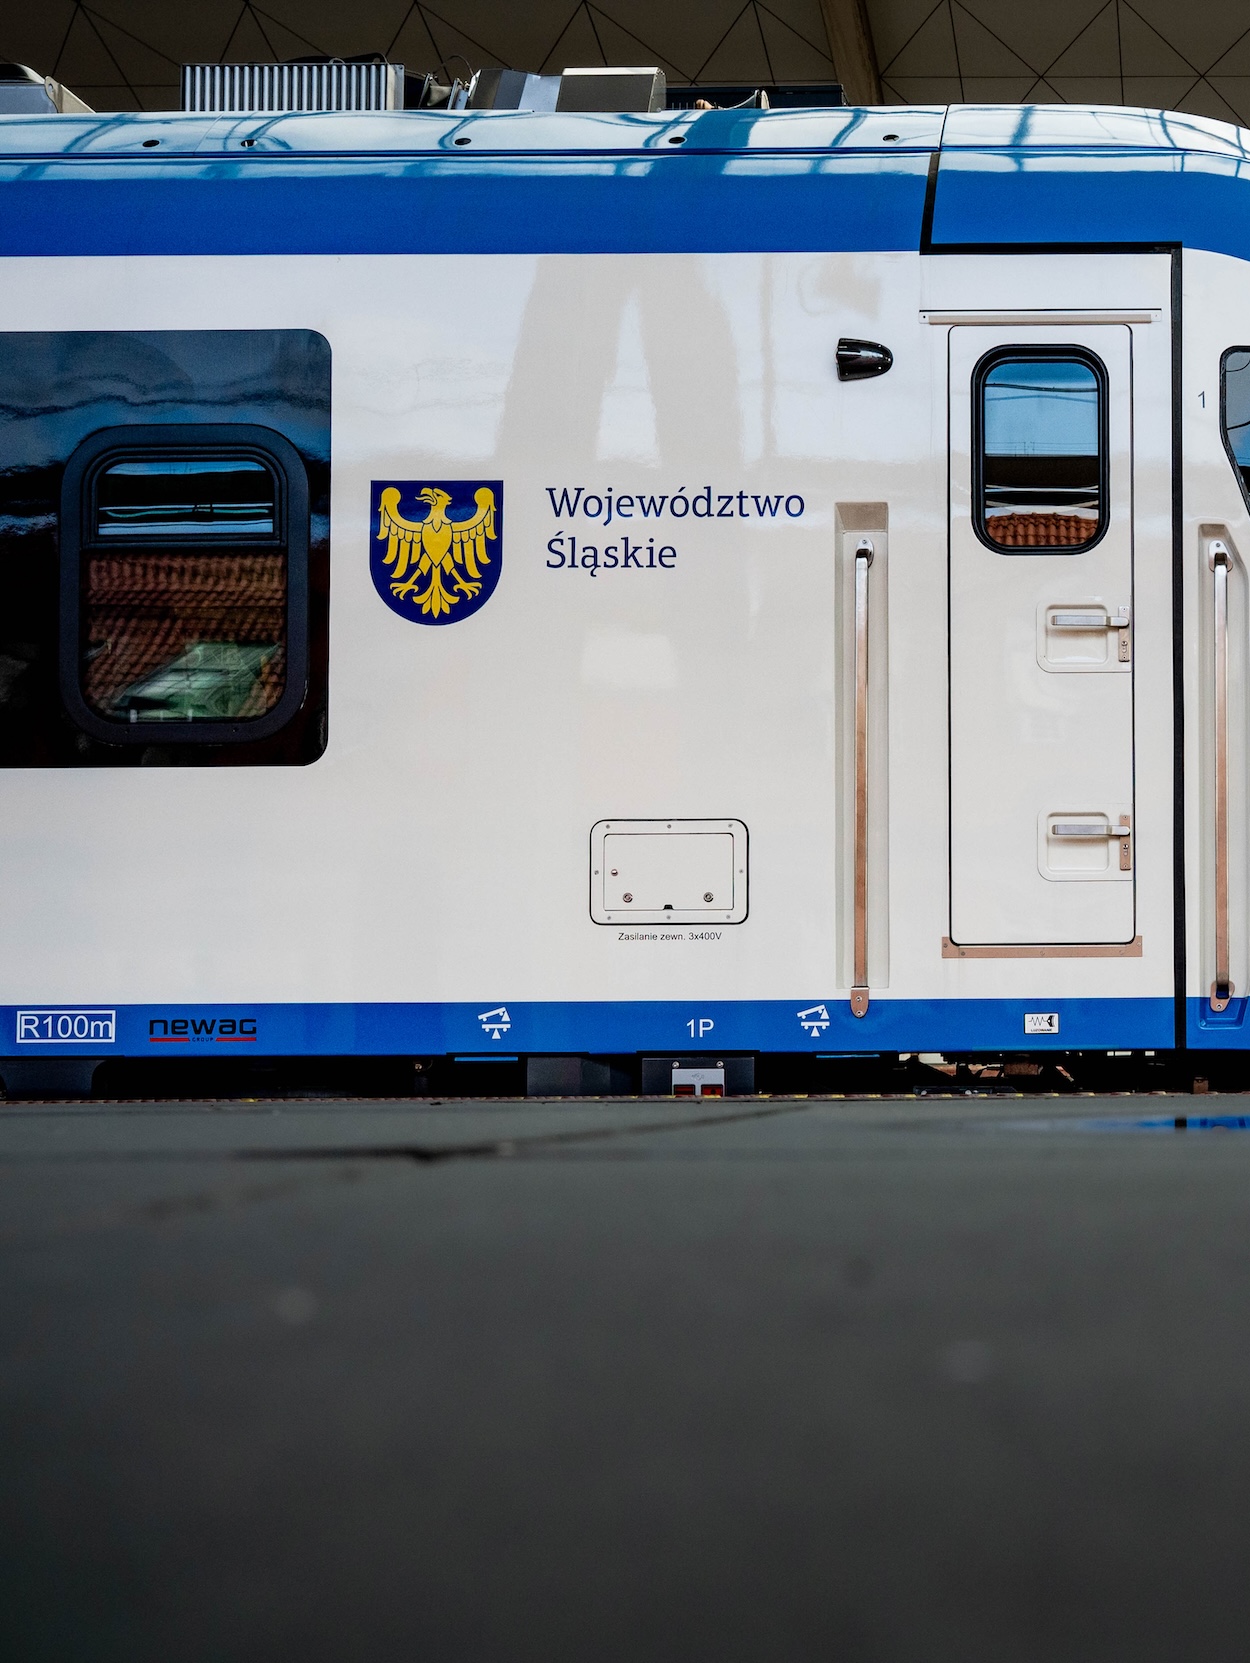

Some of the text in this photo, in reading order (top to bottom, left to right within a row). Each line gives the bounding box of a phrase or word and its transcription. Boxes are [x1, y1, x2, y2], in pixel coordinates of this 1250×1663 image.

[1197, 390, 1205, 409] 1
[545, 486, 805, 527] Województwo
[546, 530, 678, 578] Śląskie
[618, 931, 722, 941] Zasilanie zewn. 3x400V
[20, 1014, 113, 1039] R100m
[686, 1018, 715, 1038] 1P
